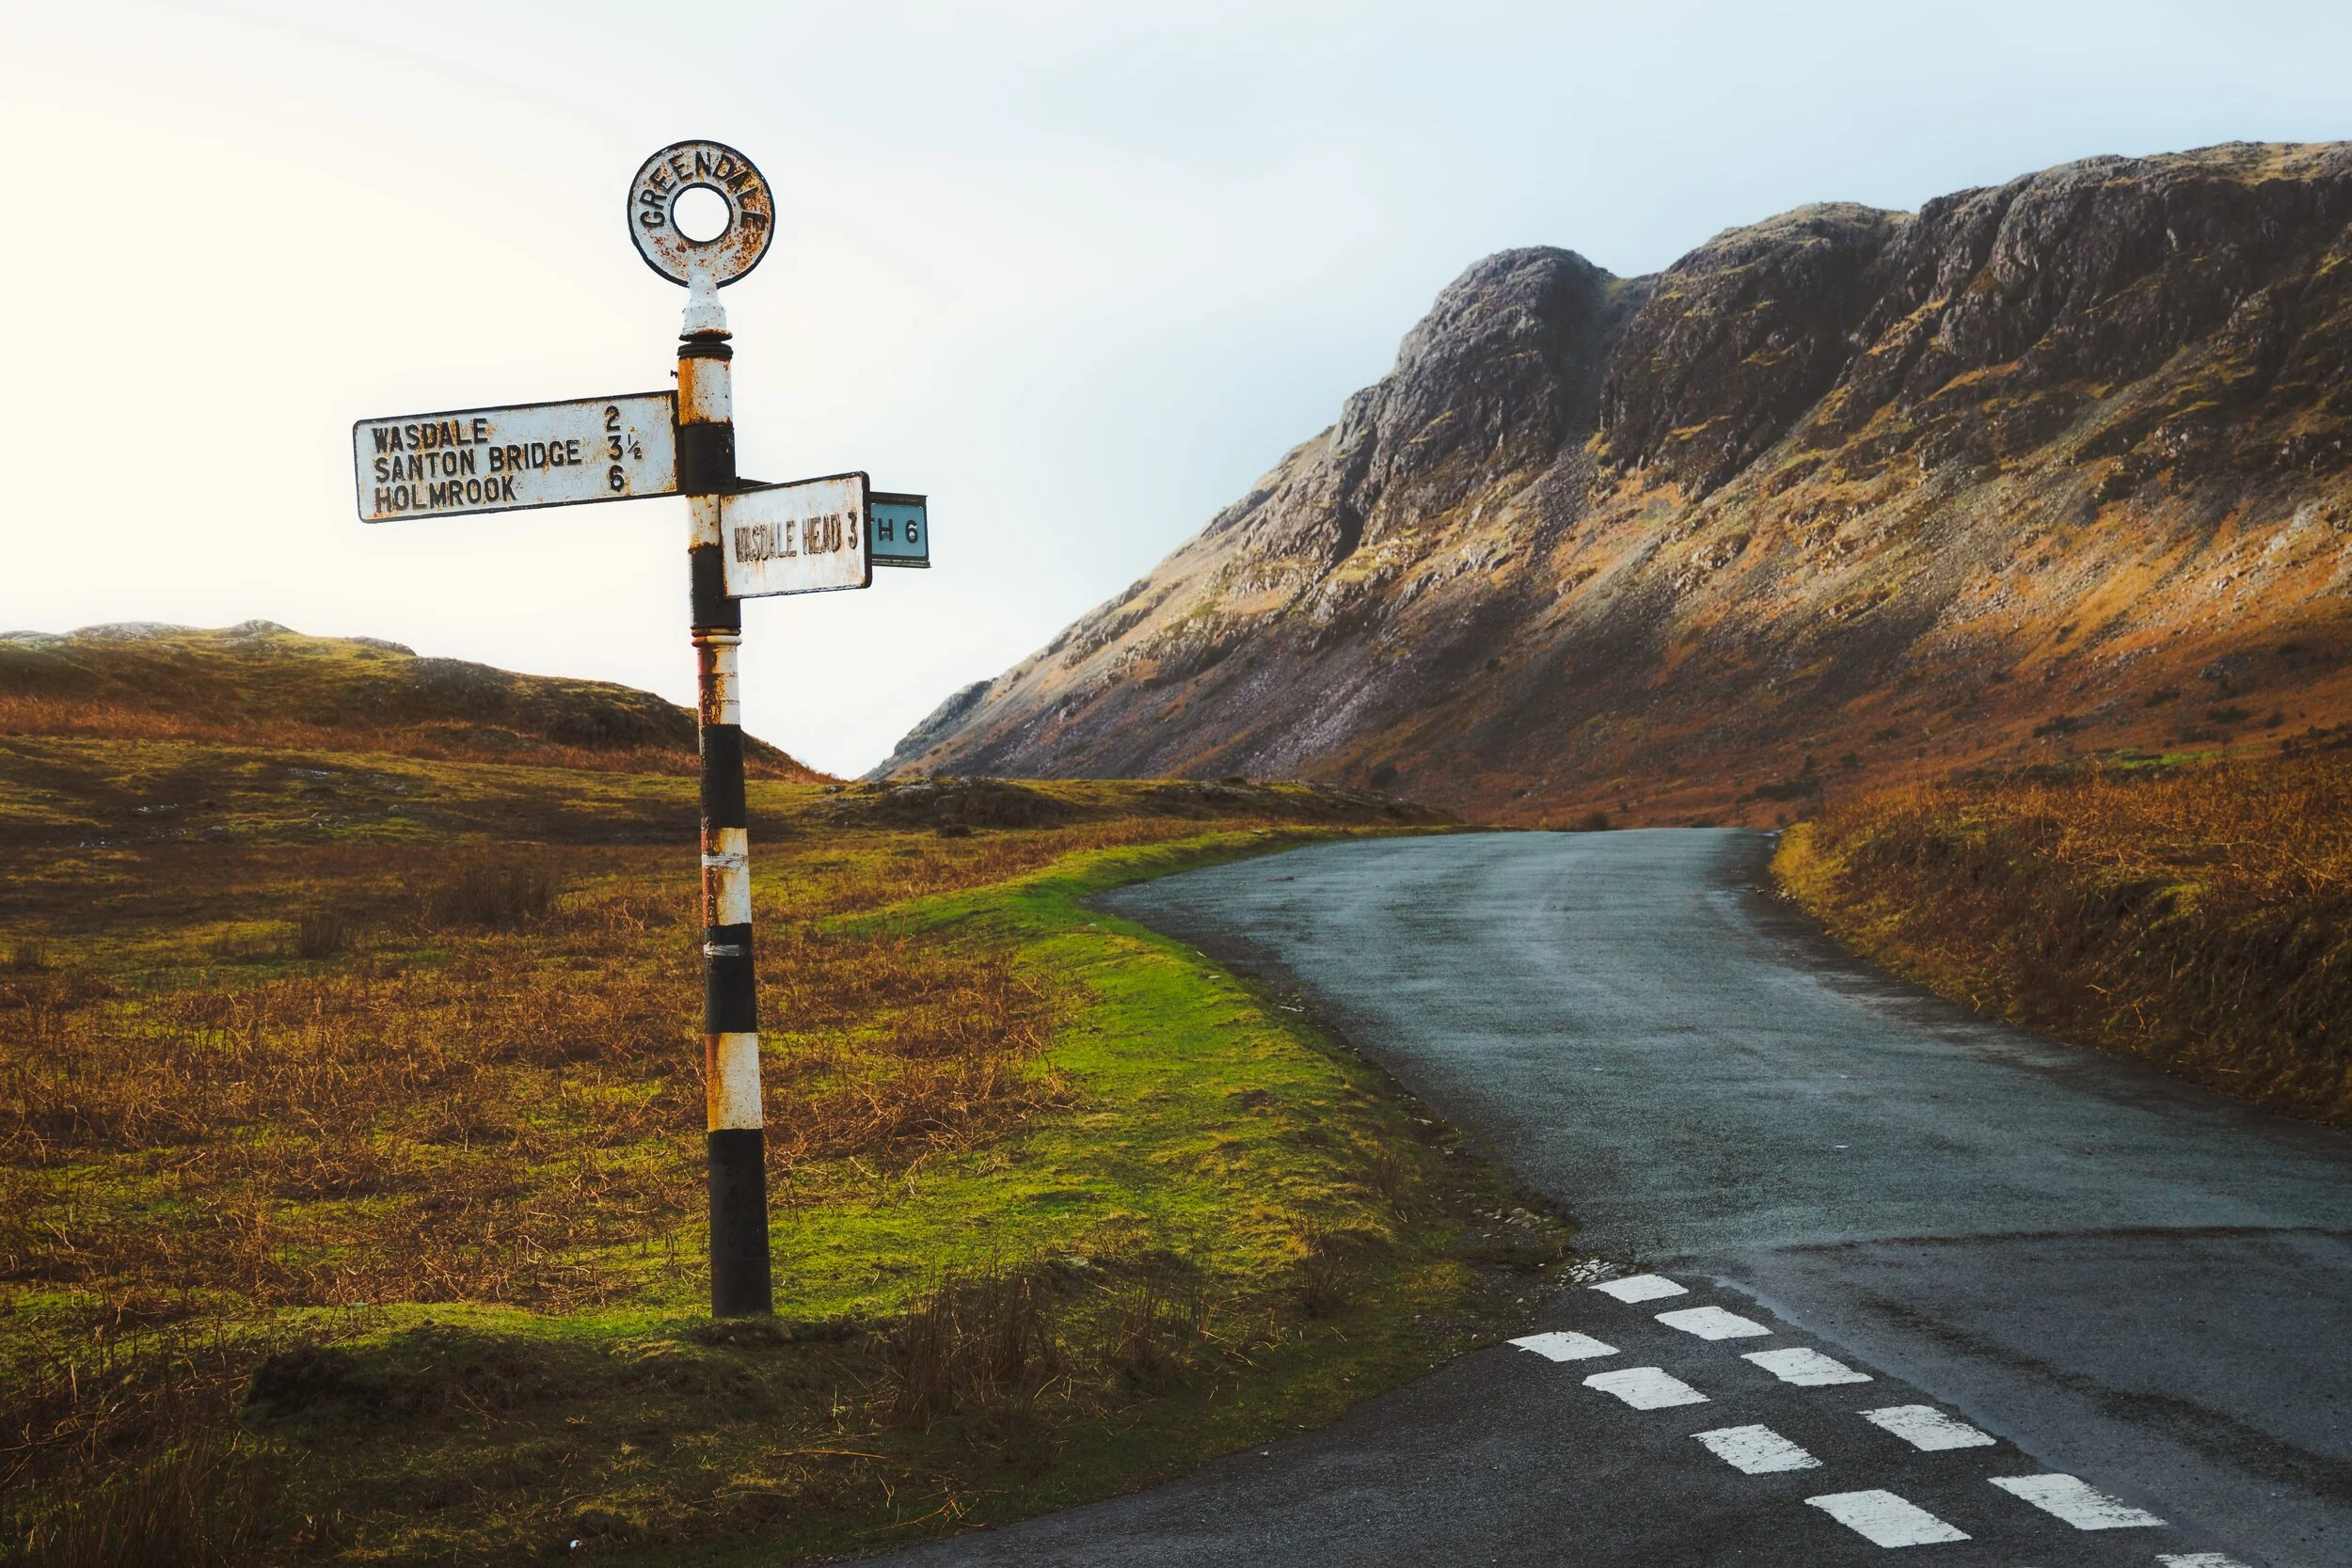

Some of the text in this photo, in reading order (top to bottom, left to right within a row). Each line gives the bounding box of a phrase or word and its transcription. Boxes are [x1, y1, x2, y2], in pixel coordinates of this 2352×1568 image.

[640, 150, 767, 231] GREENDALE
[372, 405, 621, 454] WASDALE 2
[375, 449, 476, 484] SANTON
[489, 439, 583, 473] BRIDGE
[375, 465, 626, 515] HOLMROOK 6
[735, 511, 859, 563] WASDALE HEAD 3
[871, 517, 919, 545] H 6
